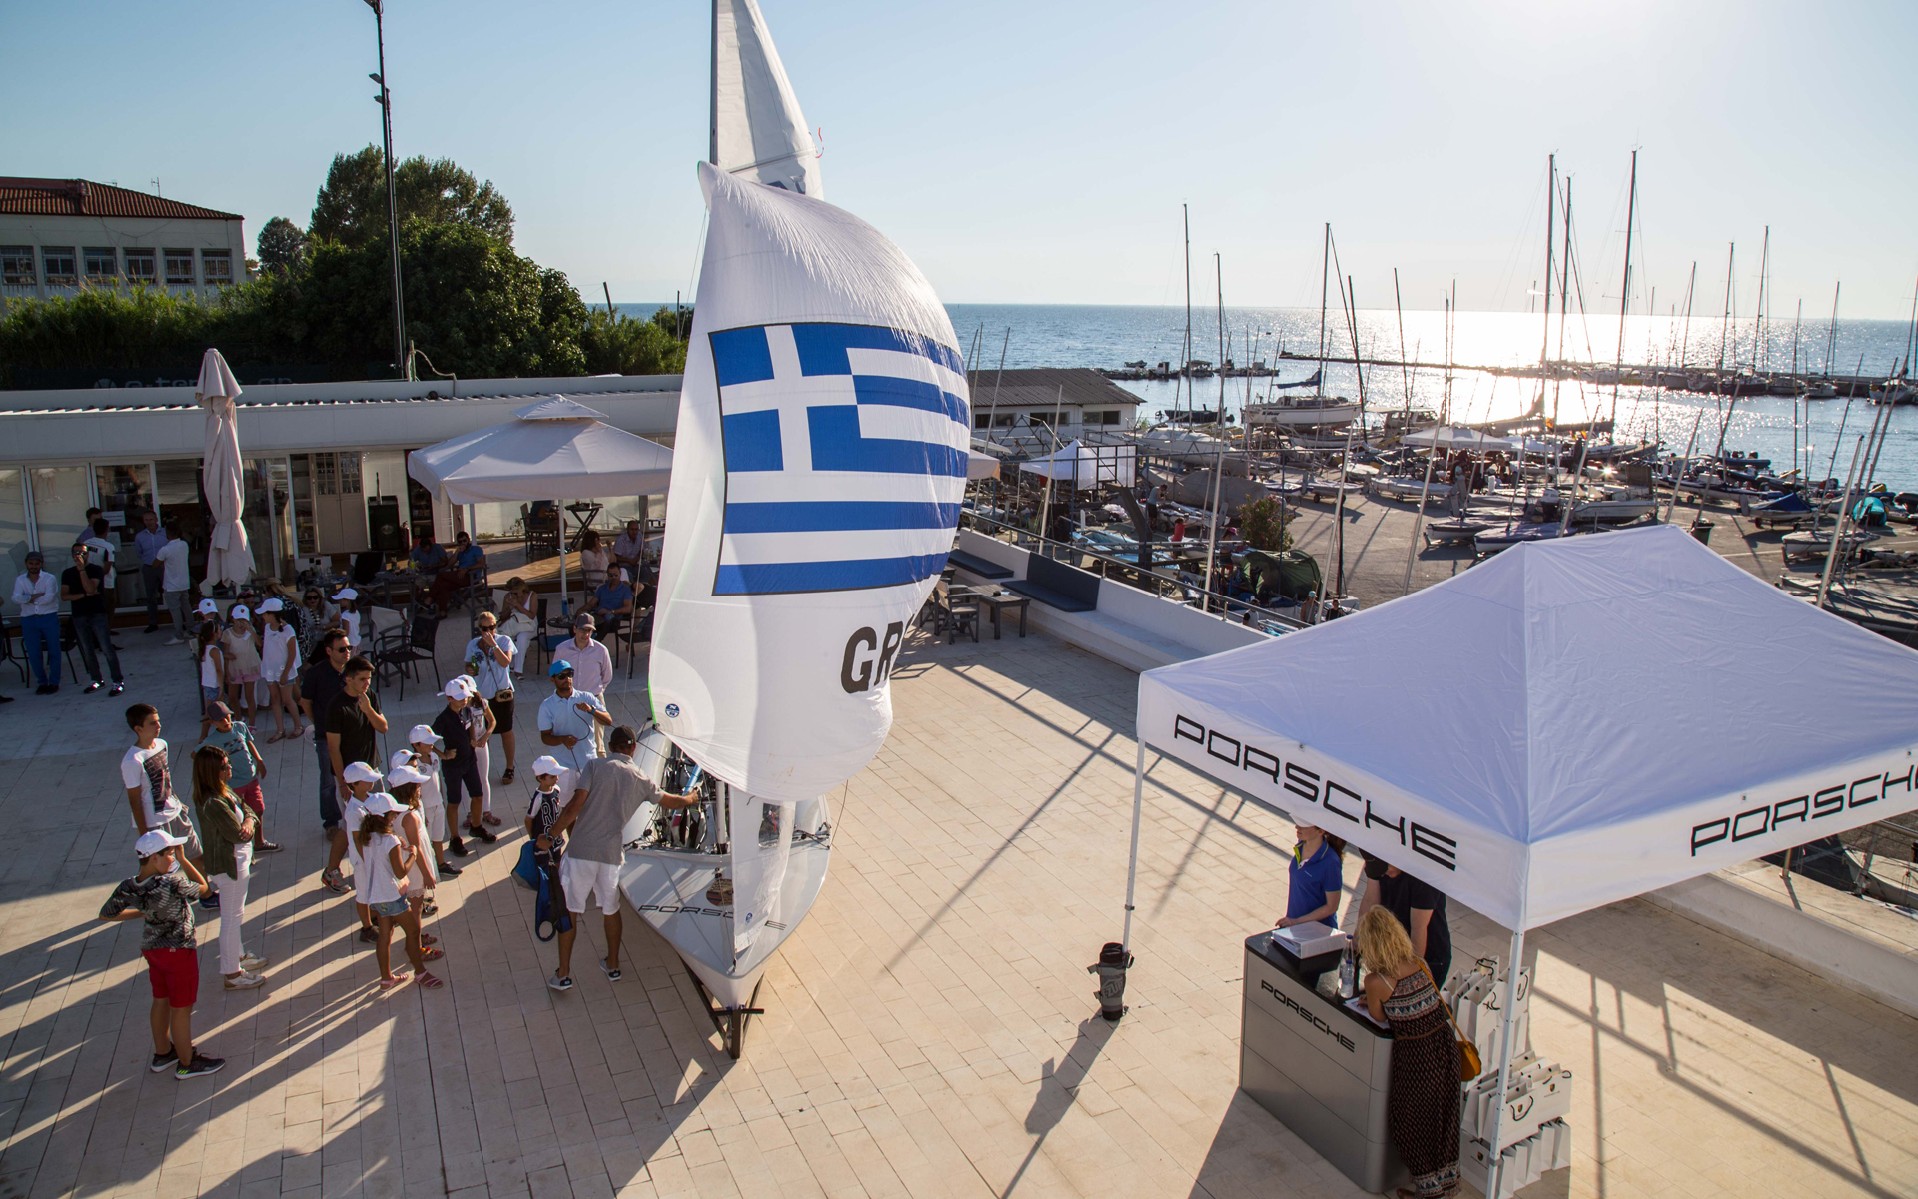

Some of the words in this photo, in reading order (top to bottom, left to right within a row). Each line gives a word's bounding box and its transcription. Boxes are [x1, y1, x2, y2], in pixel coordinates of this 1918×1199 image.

[841, 614, 915, 694] GR
[1174, 714, 1457, 871] PORSCHE
[1691, 764, 1918, 857] PORSCH
[1261, 979, 1355, 1053] PORSCHE
